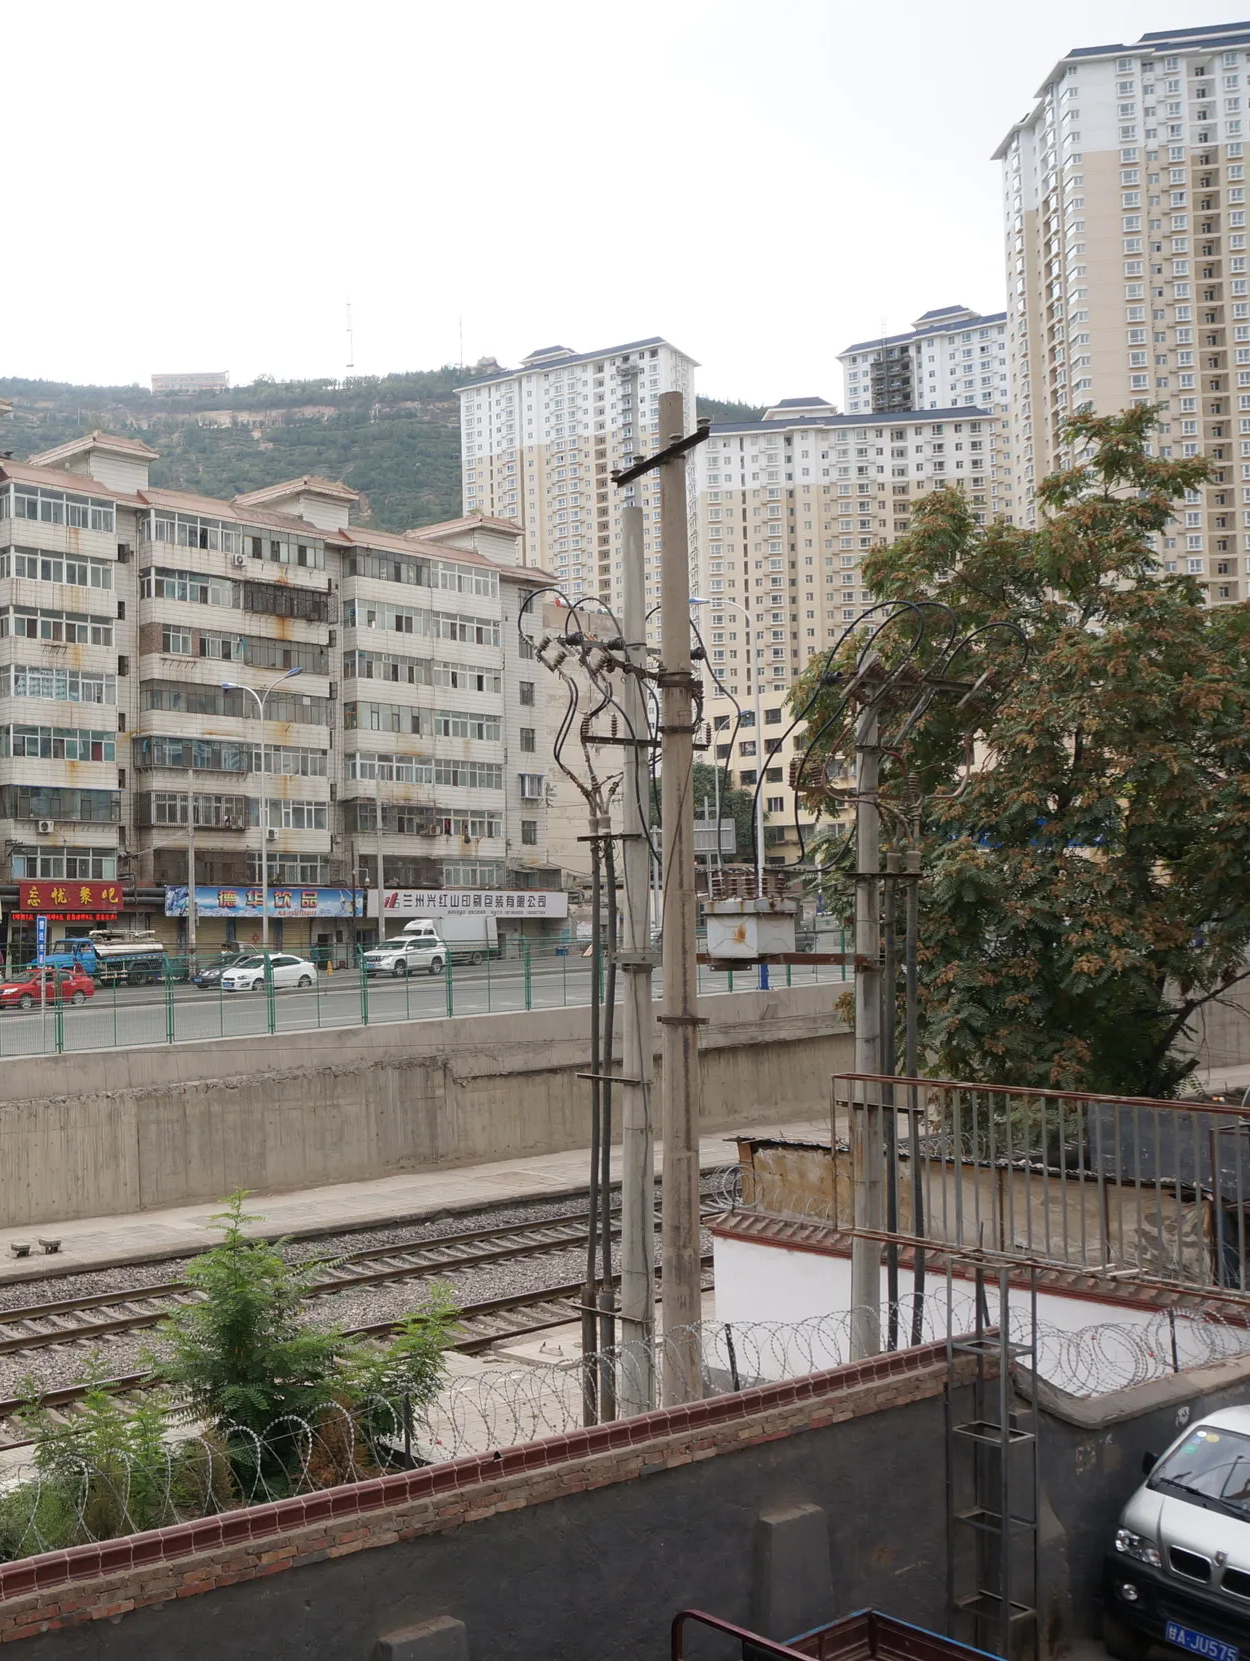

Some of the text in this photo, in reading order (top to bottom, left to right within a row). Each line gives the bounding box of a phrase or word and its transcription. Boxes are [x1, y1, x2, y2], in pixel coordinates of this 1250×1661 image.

[26, 885, 119, 907] 忘忧聚吧
[217, 889, 319, 909] 德华饮品
[402, 893, 547, 909] 兰州兴红山印刷包装有限公司
